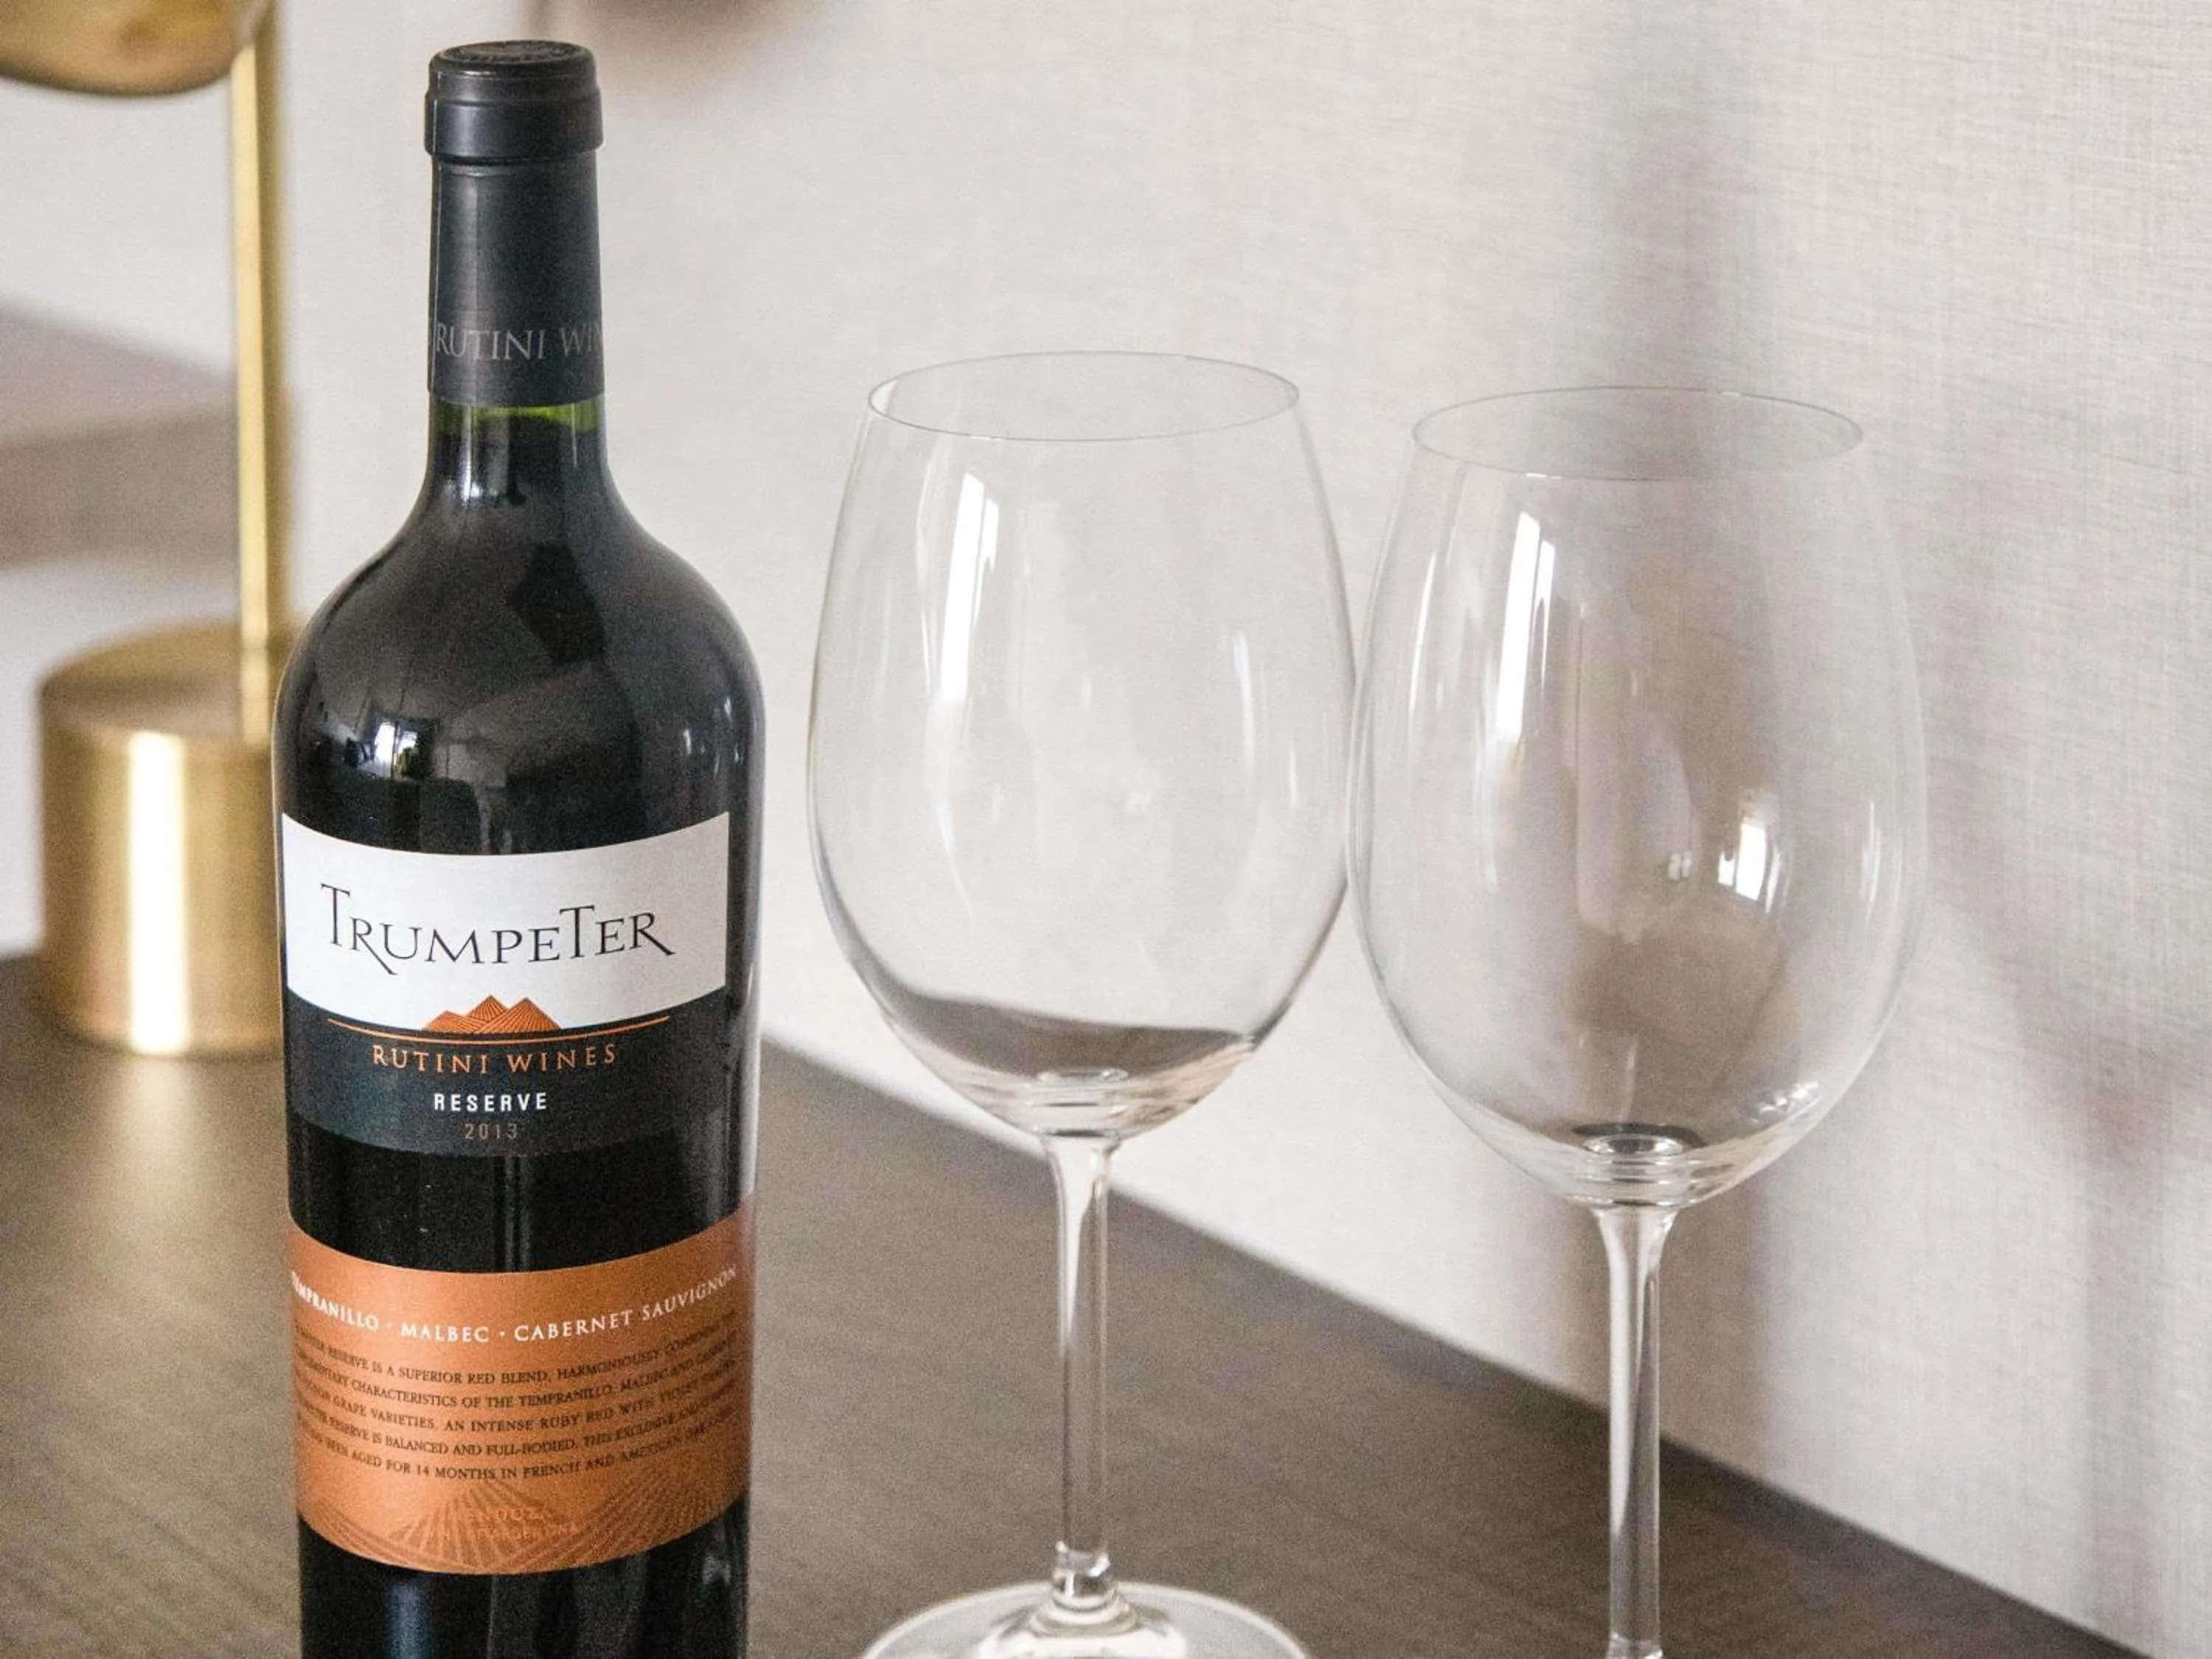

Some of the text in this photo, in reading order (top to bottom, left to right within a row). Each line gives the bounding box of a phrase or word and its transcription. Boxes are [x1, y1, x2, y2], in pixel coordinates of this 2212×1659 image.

[436, 322, 546, 364] RUTINI
[320, 883, 676, 975] TRUMPETER
[372, 1043, 615, 1074] RUTINI WINES
[434, 1092, 547, 1113] RESERVE
[465, 1123, 518, 1140] 2013
[401, 1322, 489, 1343] MALBEC
[514, 1310, 633, 1342] CABERNET
[642, 1264, 736, 1321] SAUVIGNON
[372, 1360, 382, 1374] IS
[387, 1366, 394, 1377] A
[399, 1367, 462, 1384] SUPERIOR
[467, 1371, 495, 1385] RED
[352, 1379, 456, 1408] CHARACTERISTICS
[461, 1395, 481, 1408] OF
[487, 1395, 514, 1408] THE
[333, 1395, 367, 1416] GRAPE
[445, 1419, 465, 1432] AN
[471, 1419, 534, 1432] INTENSE
[540, 1413, 579, 1429] RUBY
[386, 1435, 449, 1454] BALANCED
[453, 1443, 481, 1455] AND
[352, 1450, 383, 1467] AGED
[386, 1458, 411, 1474] FOR
[417, 1464, 429, 1474] 14
[434, 1466, 498, 1479] MONTHS
[502, 1468, 517, 1478] IN
[523, 1461, 580, 1478] FRENCH
